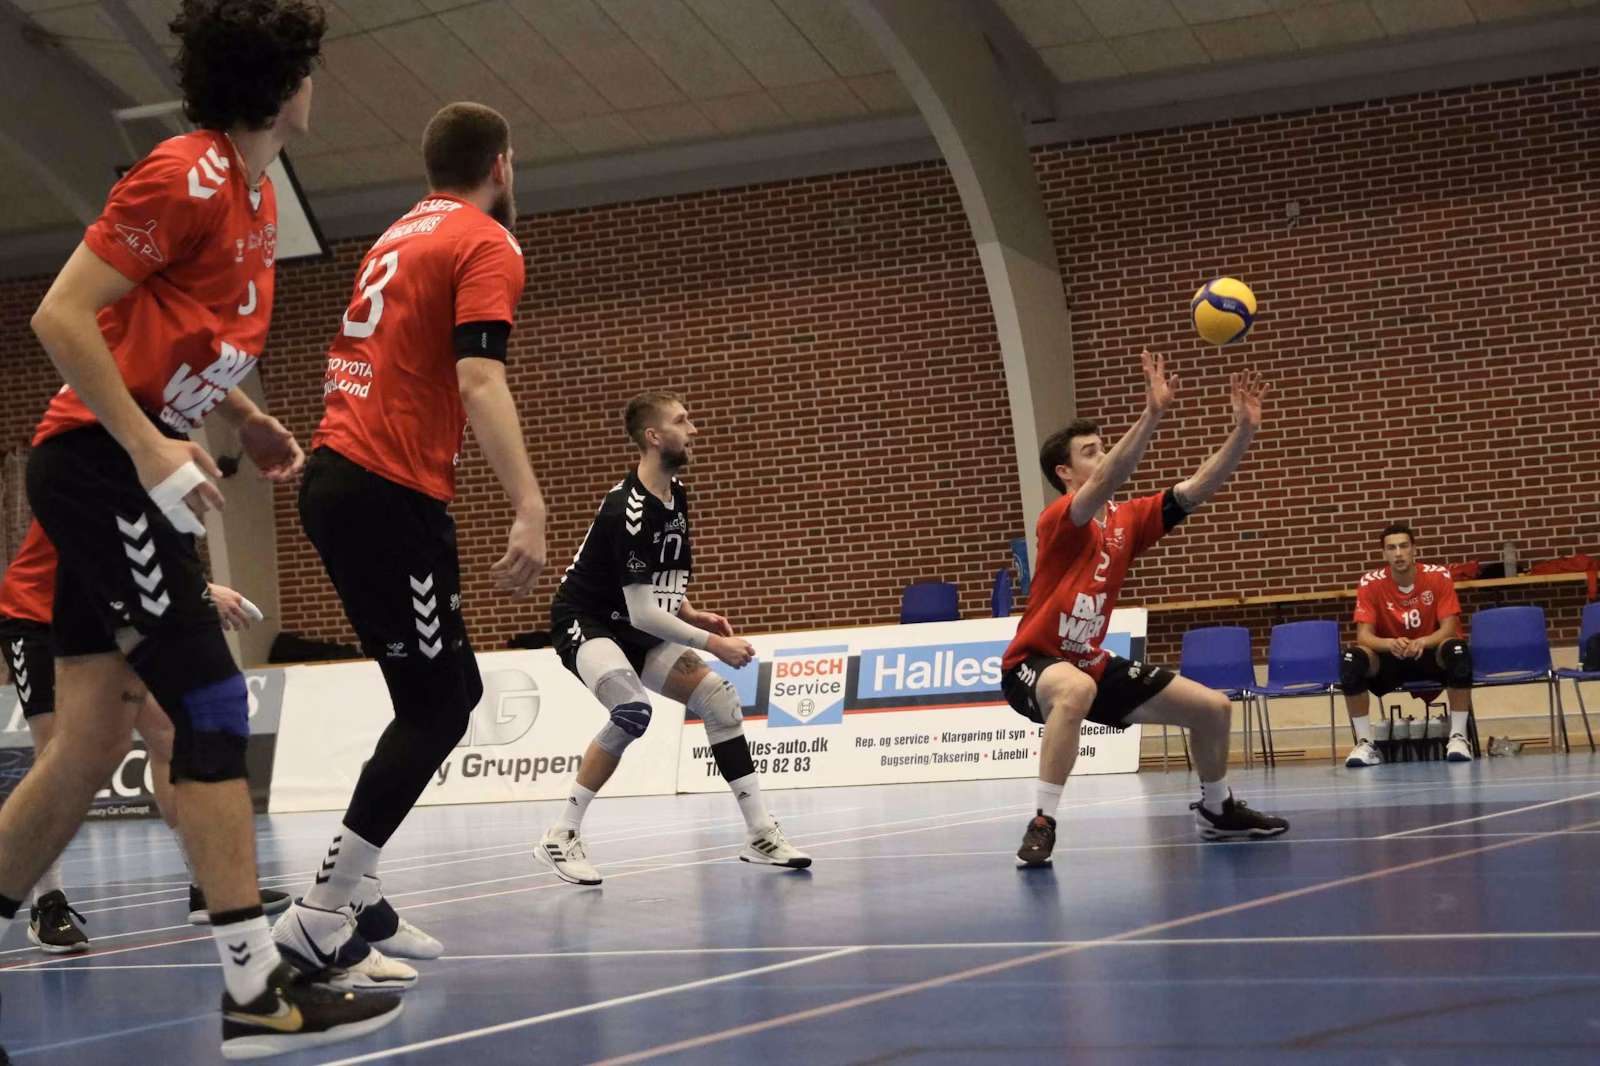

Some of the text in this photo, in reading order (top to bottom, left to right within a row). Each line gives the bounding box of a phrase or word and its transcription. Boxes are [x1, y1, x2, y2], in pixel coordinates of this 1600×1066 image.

[328, 358, 374, 378] TOYOTA
[1093, 551, 1111, 582] 2
[1402, 609, 1421, 629] 18
[776, 658, 843, 678] BOSCH
[874, 650, 1002, 692] Halles
[774, 679, 841, 697] Service
[855, 734, 930, 749] Rep. og service
[941, 730, 993, 743] Klargøring
[996, 729, 1006, 737] til
[1009, 729, 1026, 740] syn
[880, 751, 980, 767] Bugsering/Taksering
[992, 748, 1028, 761] Lånebil
[462, 753, 583, 782] Gruppen
[772, 757, 789, 773] 82
[794, 756, 811, 772] 83
[107, 805, 119, 815] Car
[120, 805, 150, 816] Concept
